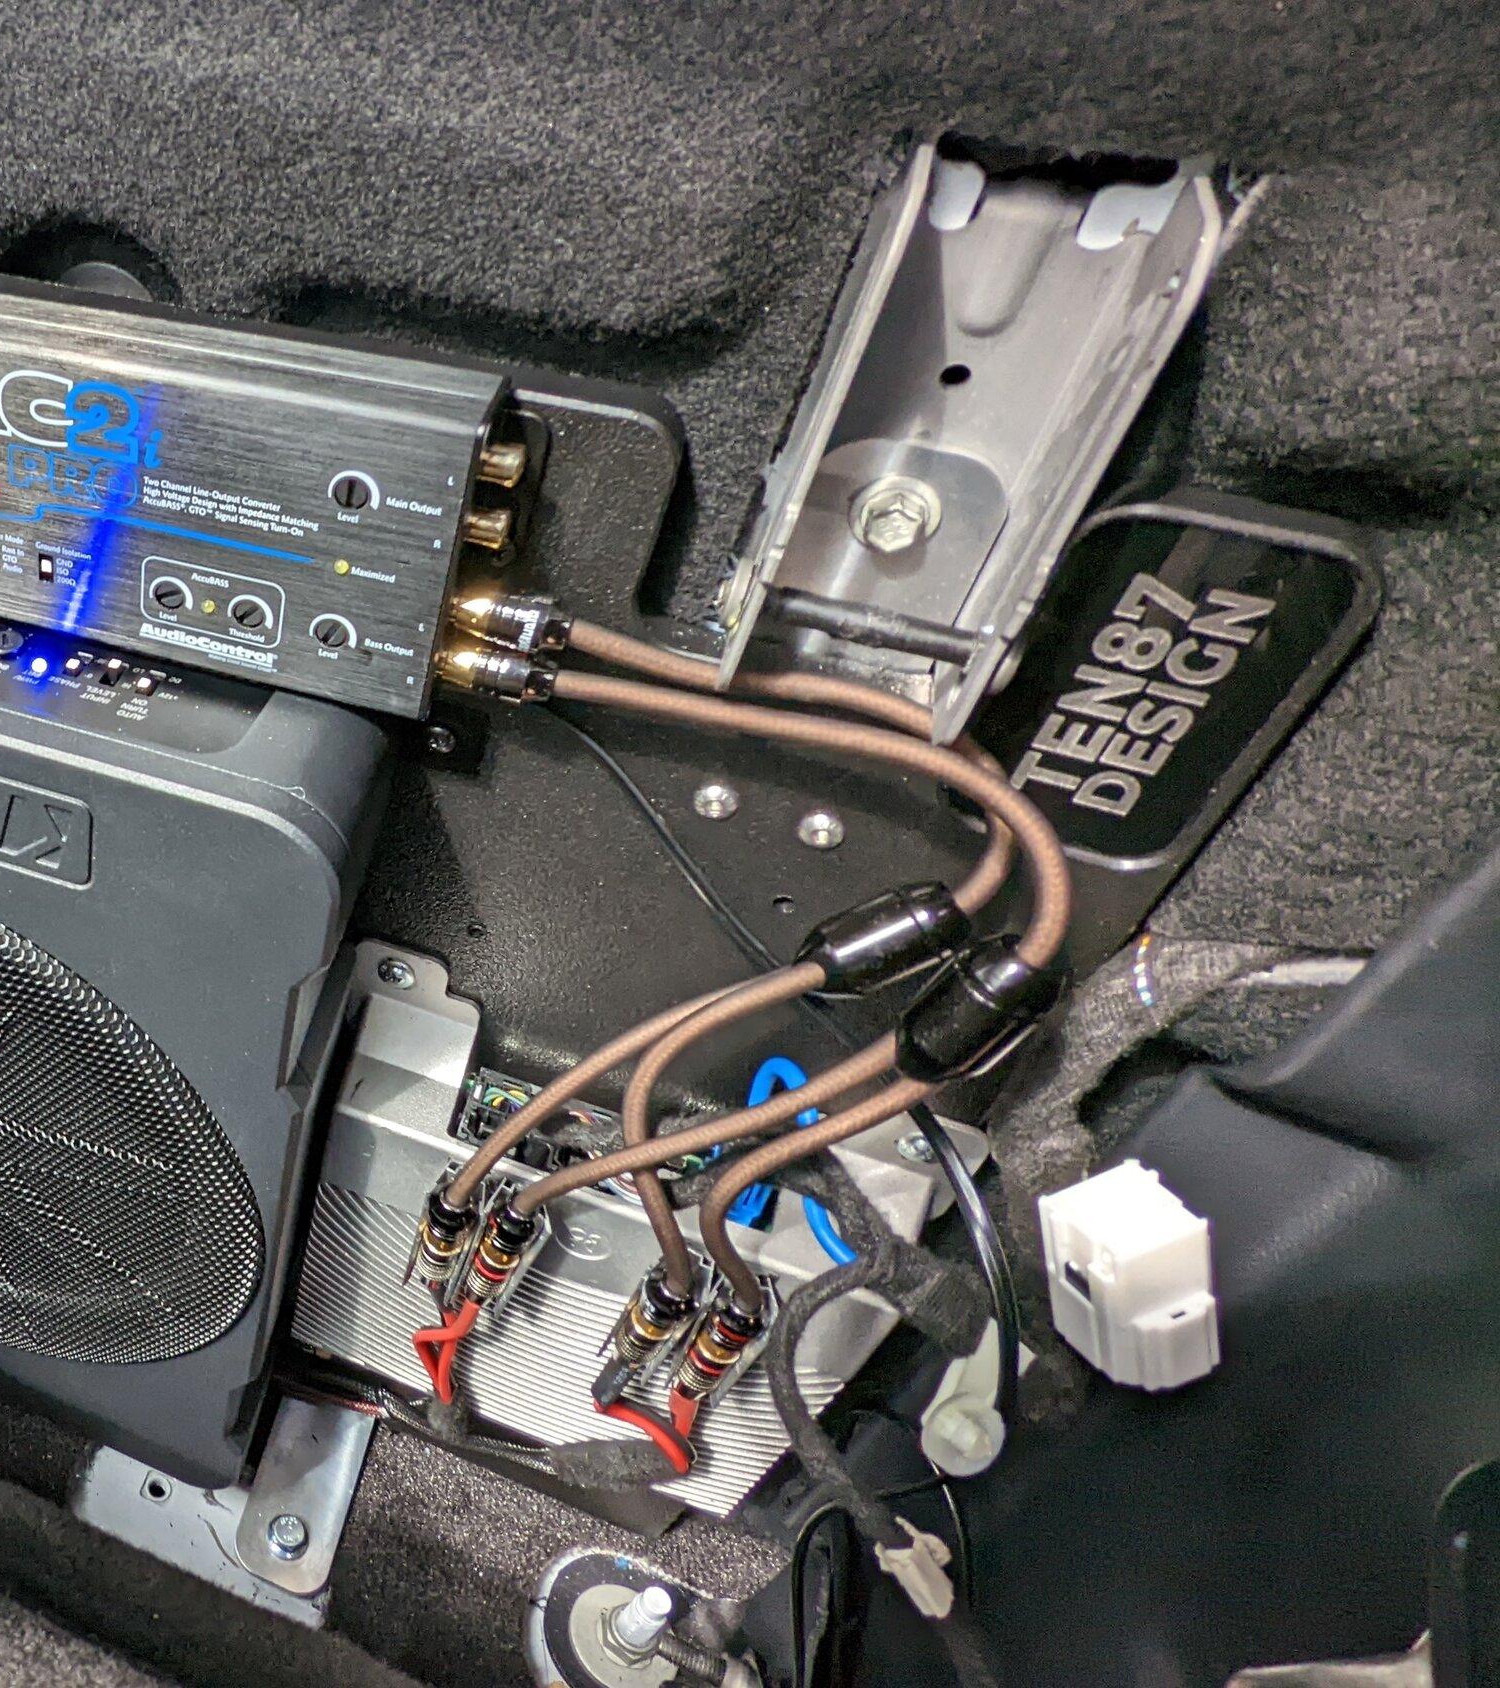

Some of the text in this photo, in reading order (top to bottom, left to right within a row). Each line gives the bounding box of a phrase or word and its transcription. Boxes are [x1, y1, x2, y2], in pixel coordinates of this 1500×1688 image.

[7, 443, 138, 507] PRO
[143, 476, 281, 512] Two Channel Line-Output Converter
[143, 486, 320, 532] High Voltage Design with Impedance Matching
[385, 496, 443, 516] Main Output
[214, 510, 238, 524] Signal
[238, 515, 269, 531] Sensing
[270, 521, 304, 537] Turn-On
[337, 511, 359, 524] Level
[5, 533, 25, 546] Mode
[1, 545, 16, 555] Rmt
[35, 541, 92, 560] Ground Isolation
[2, 554, 18, 564] GTO
[56, 557, 74, 568] GND
[2, 562, 23, 574] Audio
[56, 566, 70, 576] ISO
[351, 566, 396, 584] Maximized
[191, 572, 230, 589] AccuBASS
[158, 611, 178, 622] Level
[229, 627, 265, 643] Threshold
[317, 648, 339, 660] Level
[364, 638, 414, 657] Bass Output
[49, 675, 82, 690] PHASE
[1009, 572, 1198, 792] TEN87
[86, 684, 117, 698] LEVEL
[79, 692, 112, 705] INPUT
[131, 697, 148, 706] ON
[1072, 588, 1278, 818] DESIGN
[116, 709, 147, 722] AUTO
[120, 703, 149, 715] TURN
